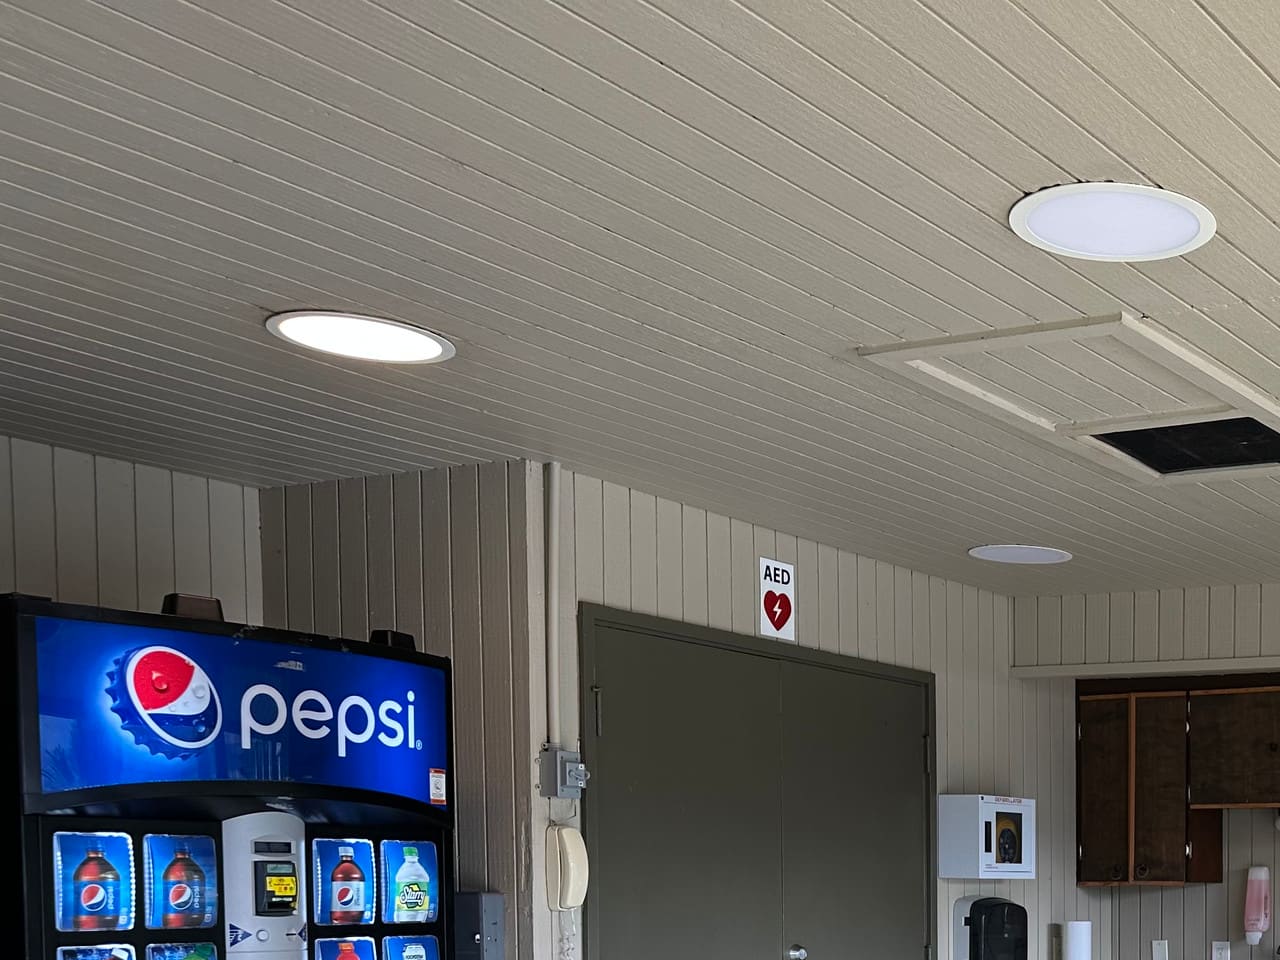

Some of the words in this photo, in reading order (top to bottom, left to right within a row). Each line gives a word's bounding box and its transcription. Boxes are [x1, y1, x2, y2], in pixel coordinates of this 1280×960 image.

[763, 564, 791, 585] AED
[240, 683, 415, 758] pepsi
[400, 885, 426, 906] Starry
